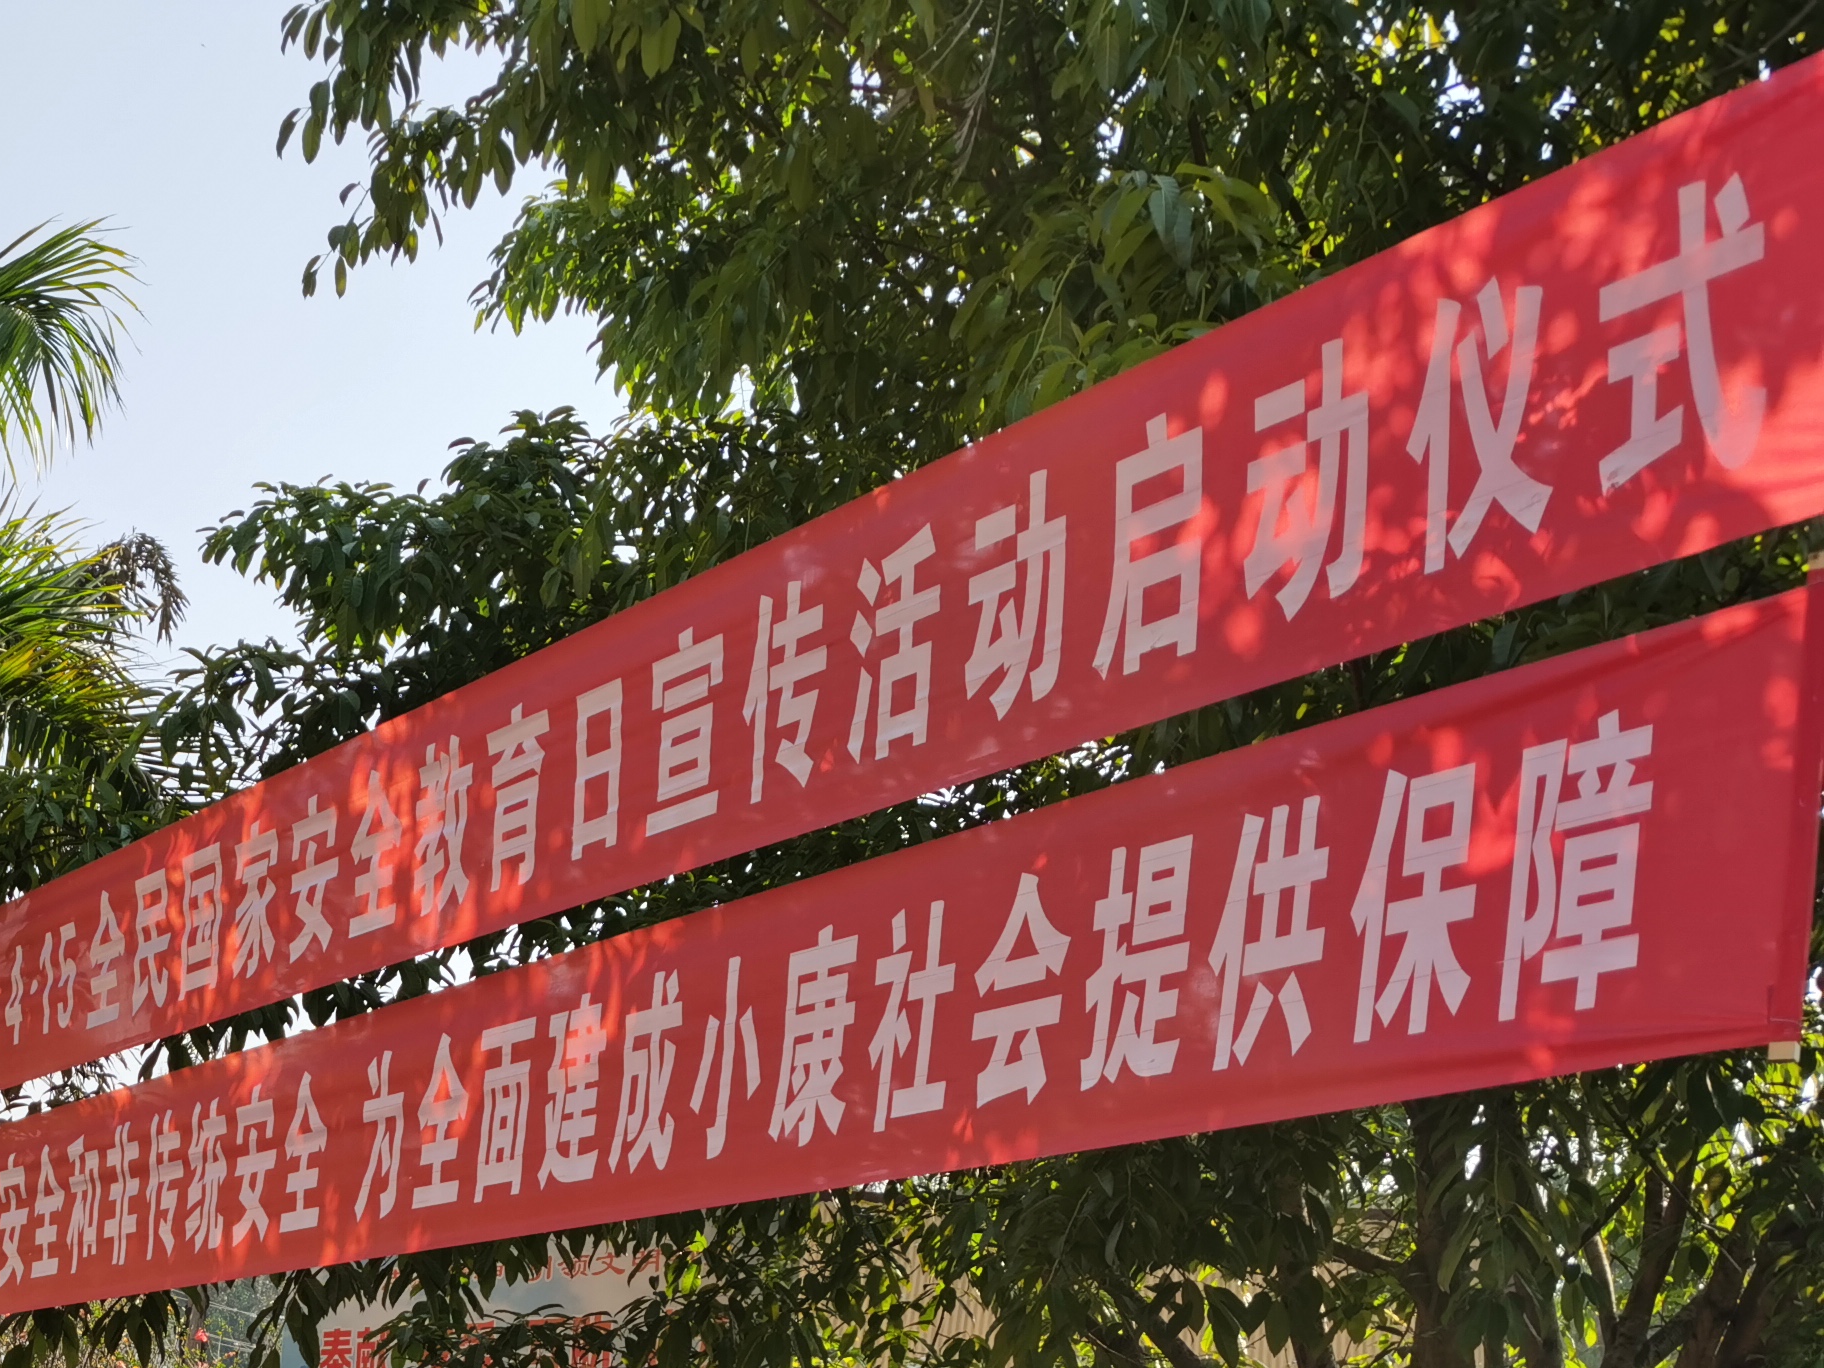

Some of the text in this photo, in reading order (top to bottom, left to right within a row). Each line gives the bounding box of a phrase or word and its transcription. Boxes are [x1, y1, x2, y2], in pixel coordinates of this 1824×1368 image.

[354, 709, 1654, 1222] 为全面建成小康社会提供保障
